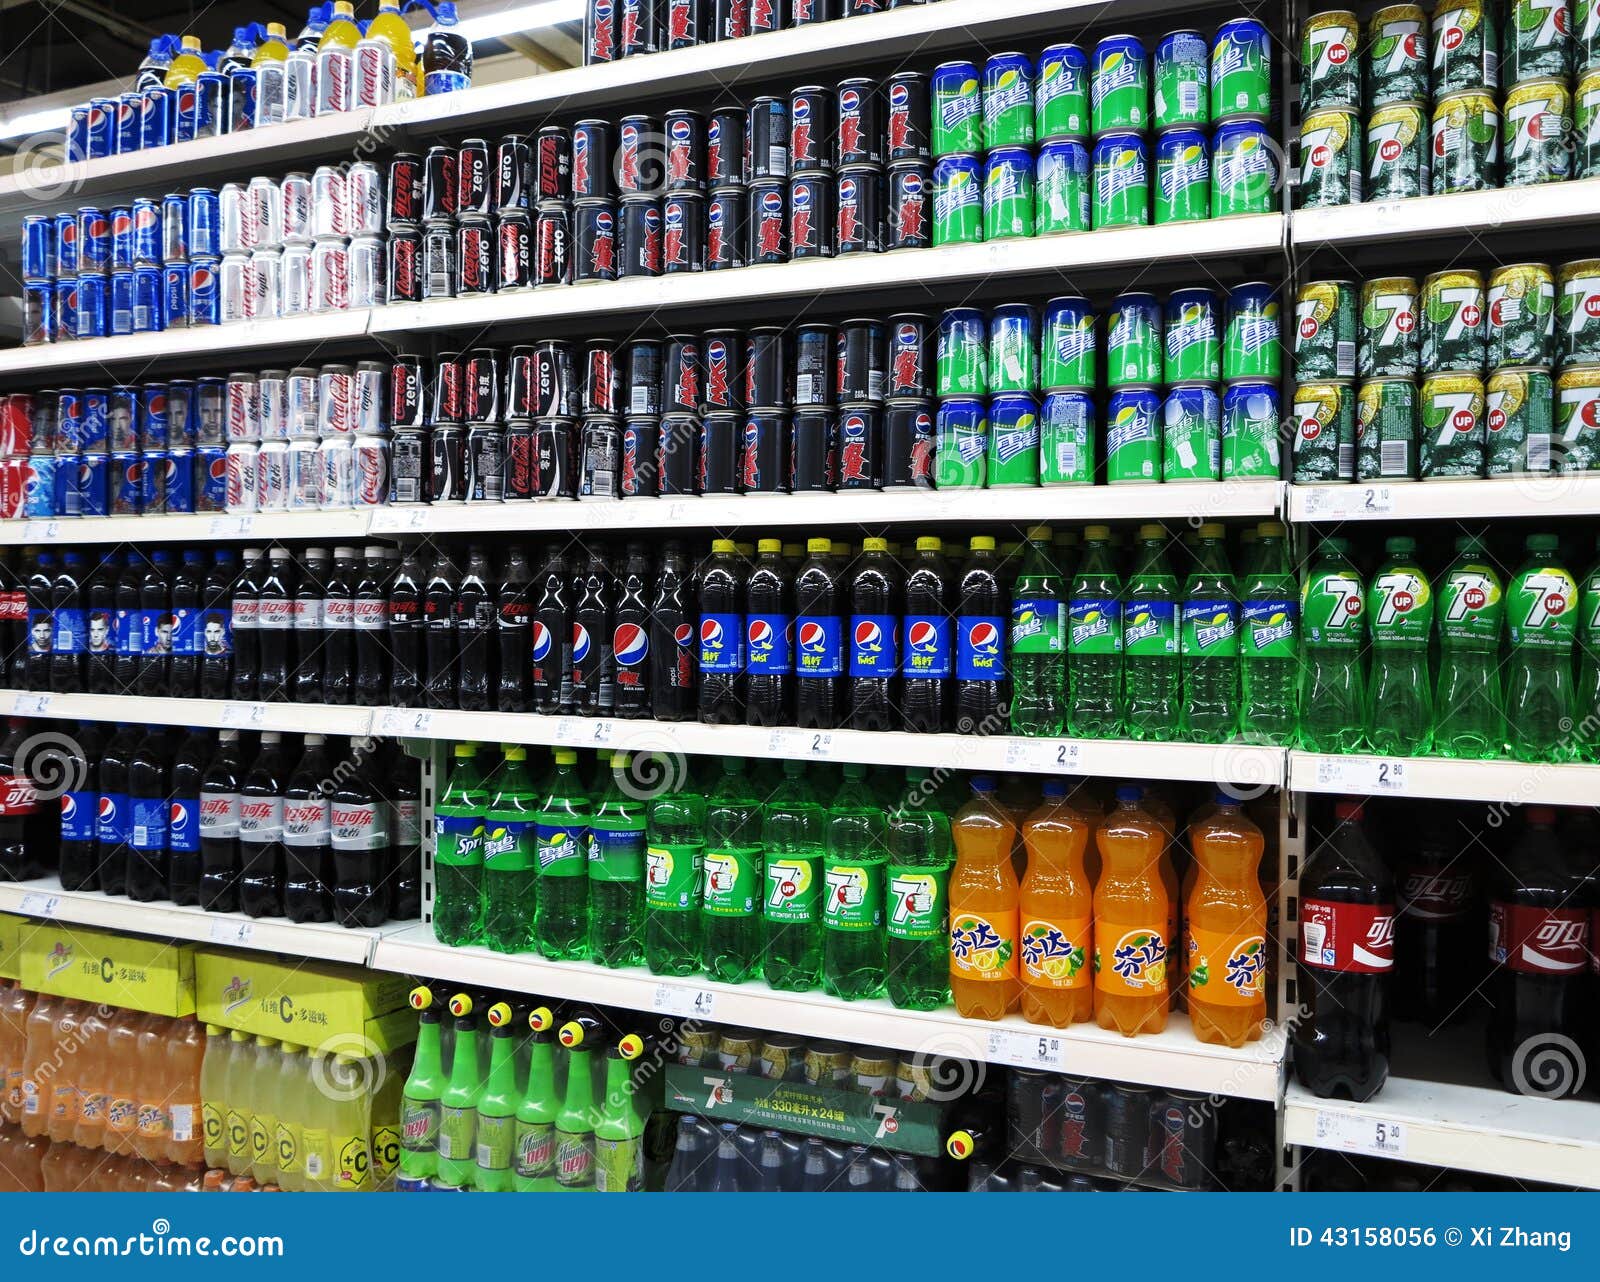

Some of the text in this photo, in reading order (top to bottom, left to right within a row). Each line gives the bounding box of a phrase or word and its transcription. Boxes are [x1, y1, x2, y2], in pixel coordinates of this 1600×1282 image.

[1365, 489, 1375, 507] 2
[415, 714, 423, 727] 2
[594, 723, 603, 738] 2
[812, 734, 821, 750] 2
[1057, 745, 1066, 763] 2
[1379, 764, 1389, 782] 2
[1393, 765, 1402, 775] 80
[457, 837, 482, 855] Spri
[951, 923, 1000, 958] 芬达
[1021, 928, 1073, 965] 芬达
[1114, 936, 1167, 978] 芬达
[695, 991, 703, 1008] 4
[1038, 1038, 1059, 1056] 5 00
[1376, 1123, 1386, 1142] 5
[1391, 1126, 1399, 1137] 30
